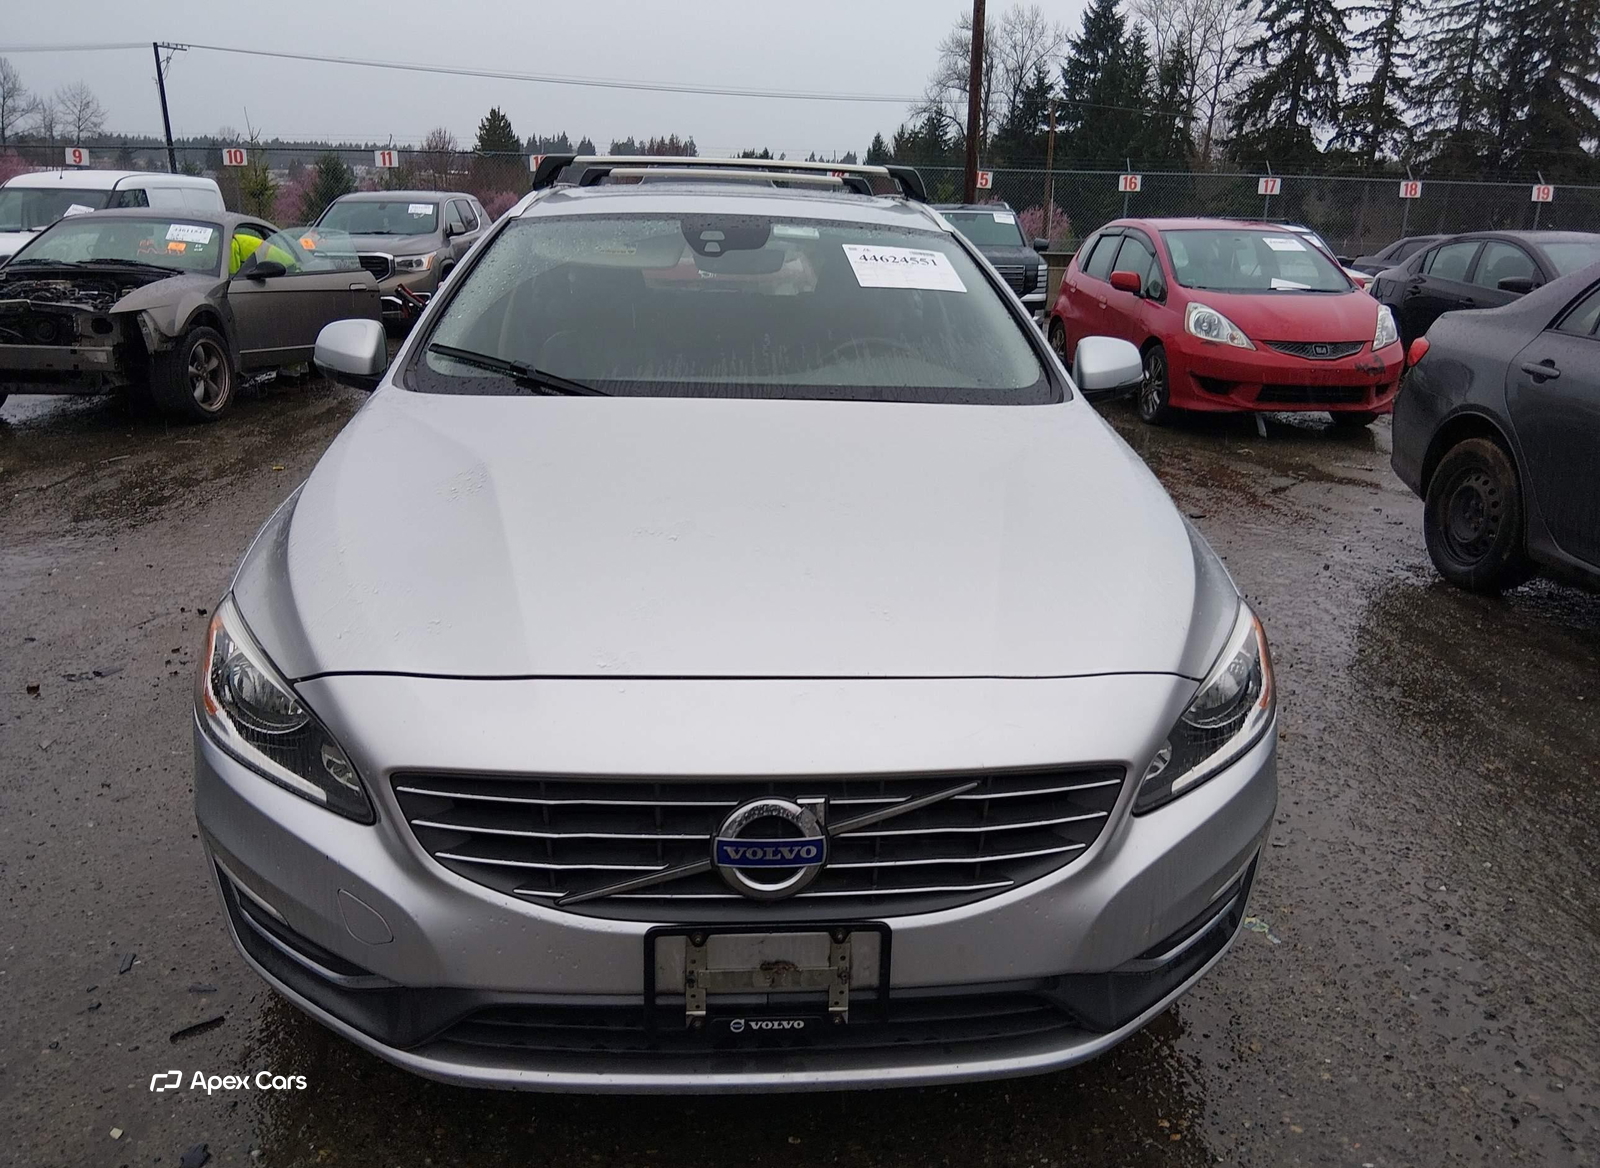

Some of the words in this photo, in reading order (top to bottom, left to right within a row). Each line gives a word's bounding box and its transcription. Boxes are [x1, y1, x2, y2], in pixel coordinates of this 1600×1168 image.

[72, 149, 83, 164] 9
[226, 149, 244, 164] 10
[380, 151, 393, 166] 11
[1123, 176, 1138, 190] 16
[1264, 179, 1277, 193] 17
[1404, 182, 1418, 196] 18
[1536, 186, 1550, 200] 19
[859, 254, 937, 266] 44624551
[723, 845, 817, 860] VOLVO
[749, 1020, 805, 1030] VOLVO
